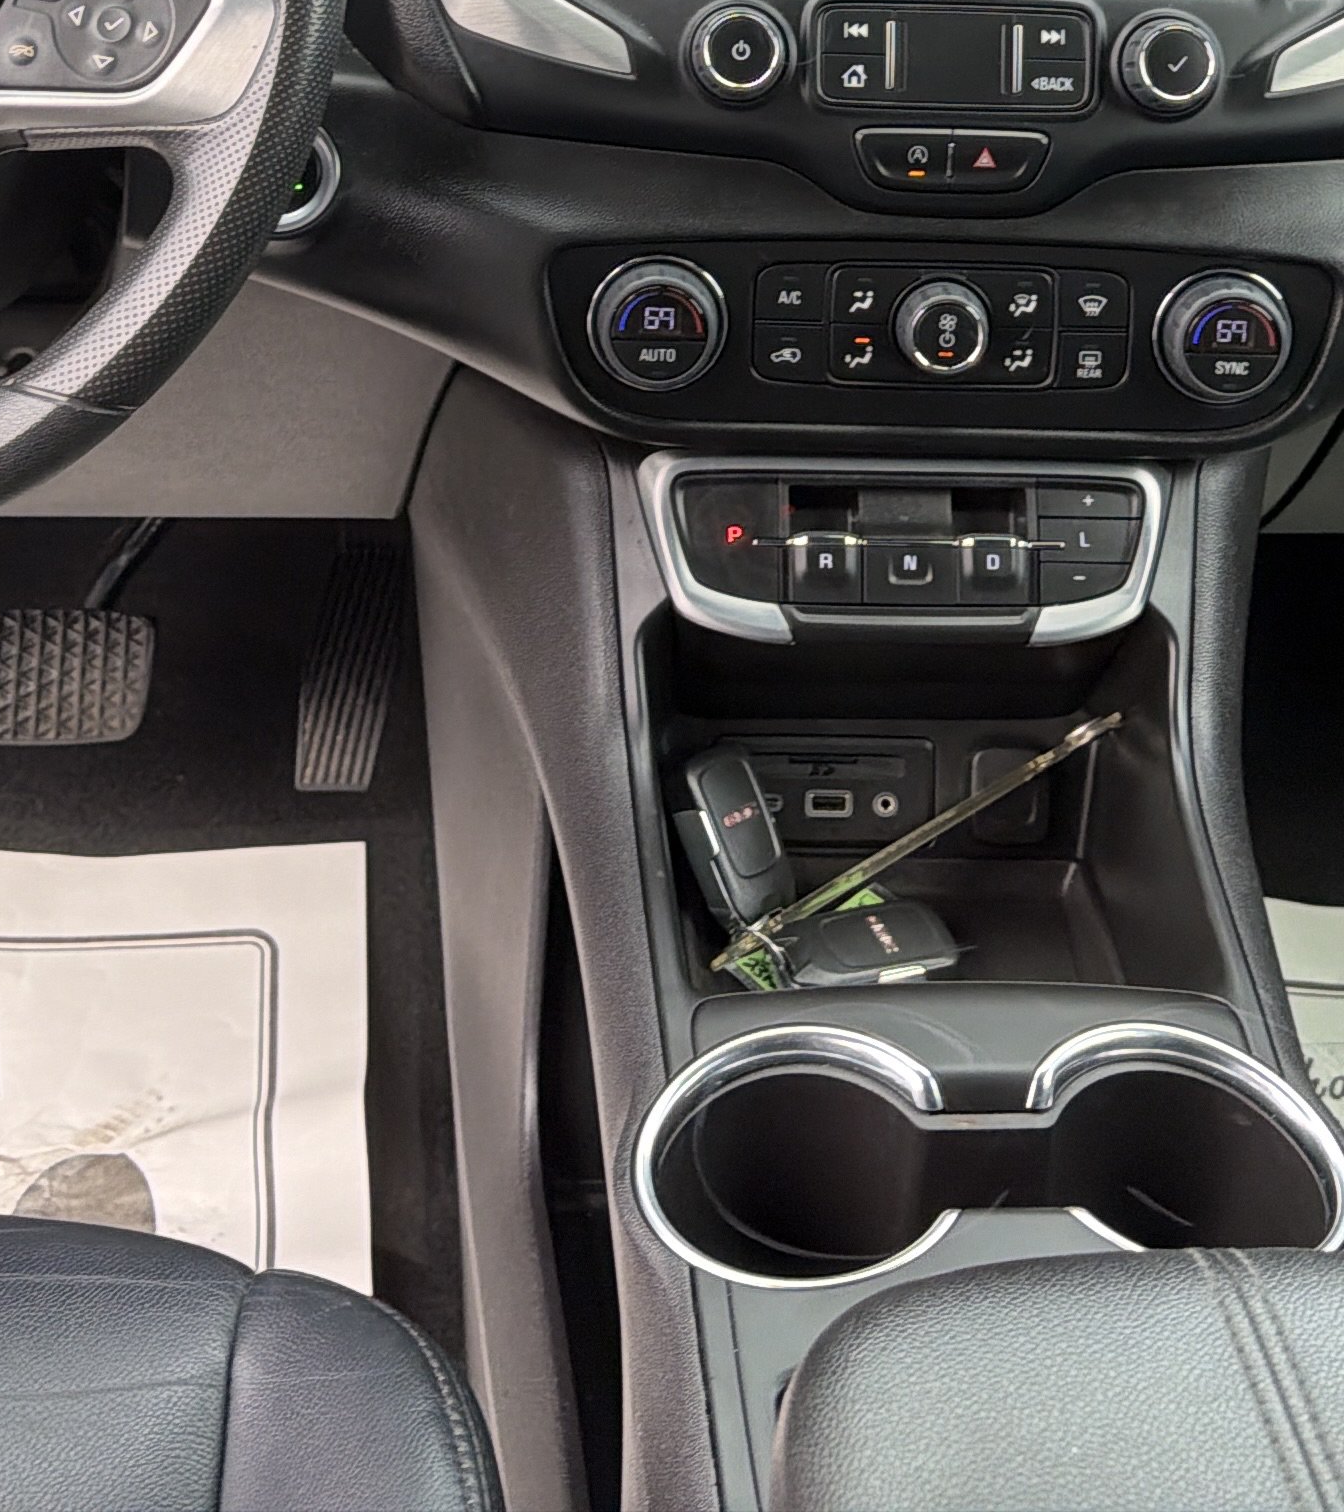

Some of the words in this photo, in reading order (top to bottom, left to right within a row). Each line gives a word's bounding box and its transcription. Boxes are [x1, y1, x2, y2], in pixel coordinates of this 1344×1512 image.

[1039, 76, 1075, 92] BACK
[778, 290, 802, 305] A/C
[643, 306, 675, 331] 69
[1215, 319, 1248, 343] 69
[639, 348, 676, 363] AUTO
[1076, 367, 1103, 379] REAR
[1214, 360, 1250, 376] SYNC
[726, 525, 743, 544] P
[1079, 531, 1091, 548] L
[819, 553, 834, 569] R
[903, 554, 918, 571] N
[986, 554, 1000, 570] D
